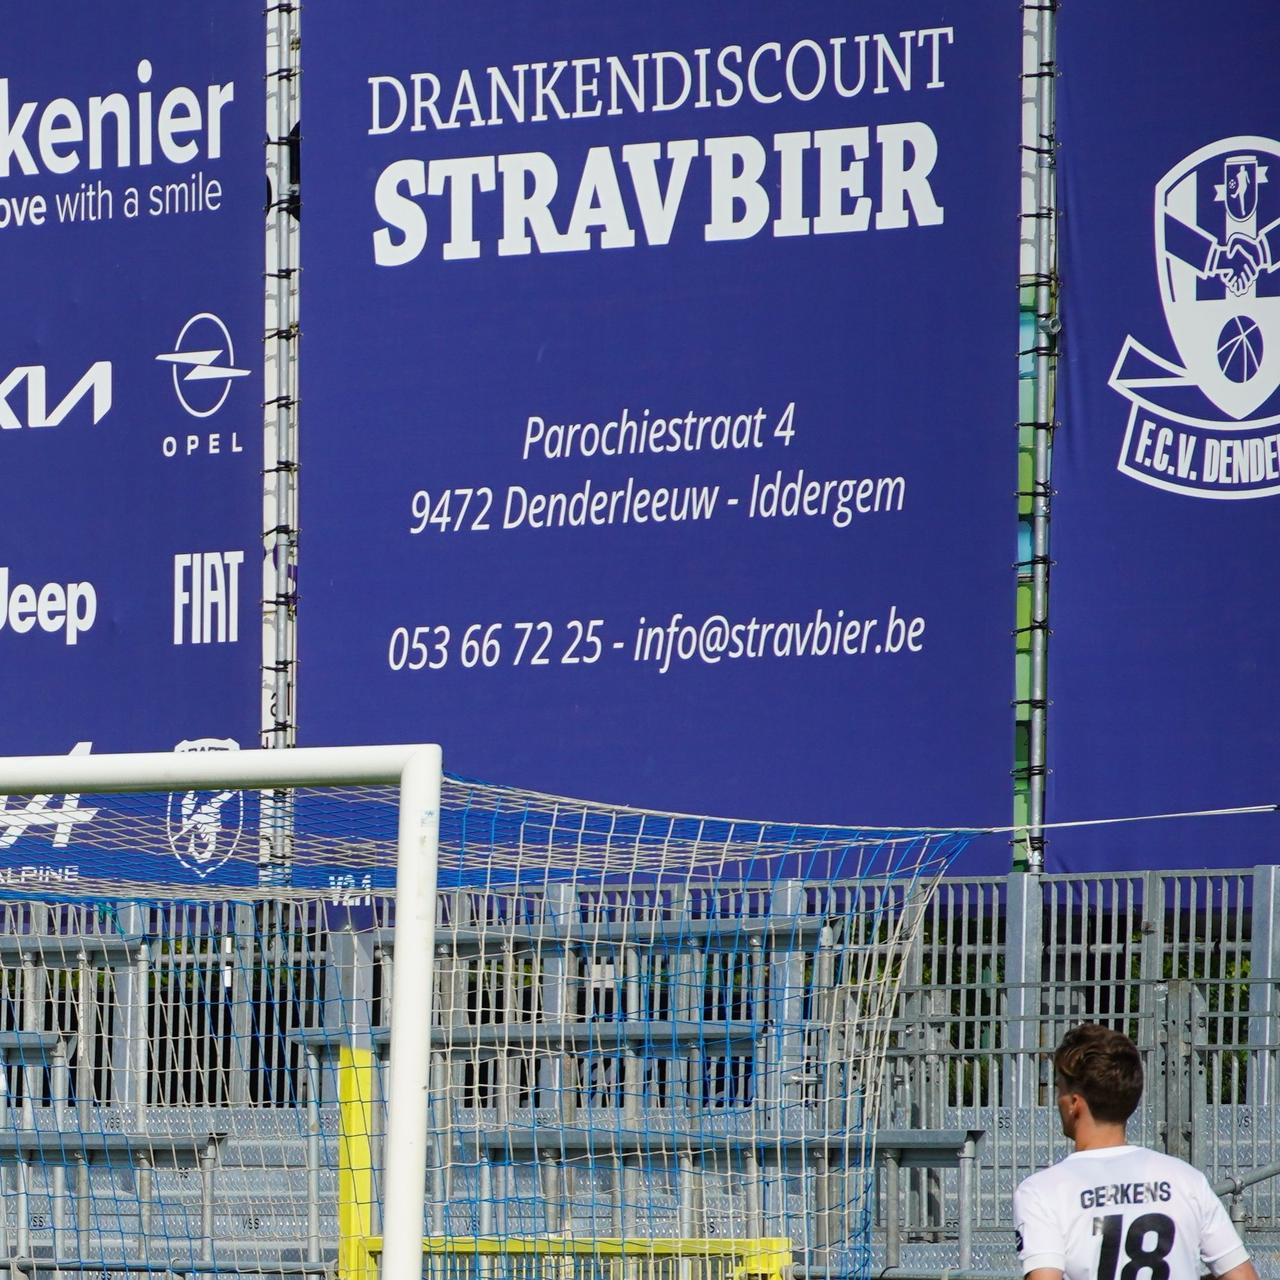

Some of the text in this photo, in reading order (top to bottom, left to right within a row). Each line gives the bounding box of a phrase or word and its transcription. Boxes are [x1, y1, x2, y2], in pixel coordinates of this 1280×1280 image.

[368, 27, 953, 134] DRANKENDISCOUNT
[56, 181, 112, 222] with
[124, 188, 138, 217] a
[150, 172, 221, 215] smile
[372, 121, 944, 267] STRAVBIER
[163, 433, 242, 457] OPEL
[523, 403, 795, 459] Parochiestraat 4
[1135, 420, 1280, 483] F.C.V. DENDE
[411, 487, 492, 533] 9472
[503, 478, 719, 528] Denderleeuw
[750, 470, 905, 527] Iddergem
[174, 551, 244, 644] FIAT
[389, 626, 450, 670] 053
[461, 623, 502, 667] 66
[514, 622, 552, 665] 72
[561, 620, 603, 663] 25
[634, 606, 925, 673] info@stravbier.be
[1080, 1181, 1171, 1209] GERKENS
